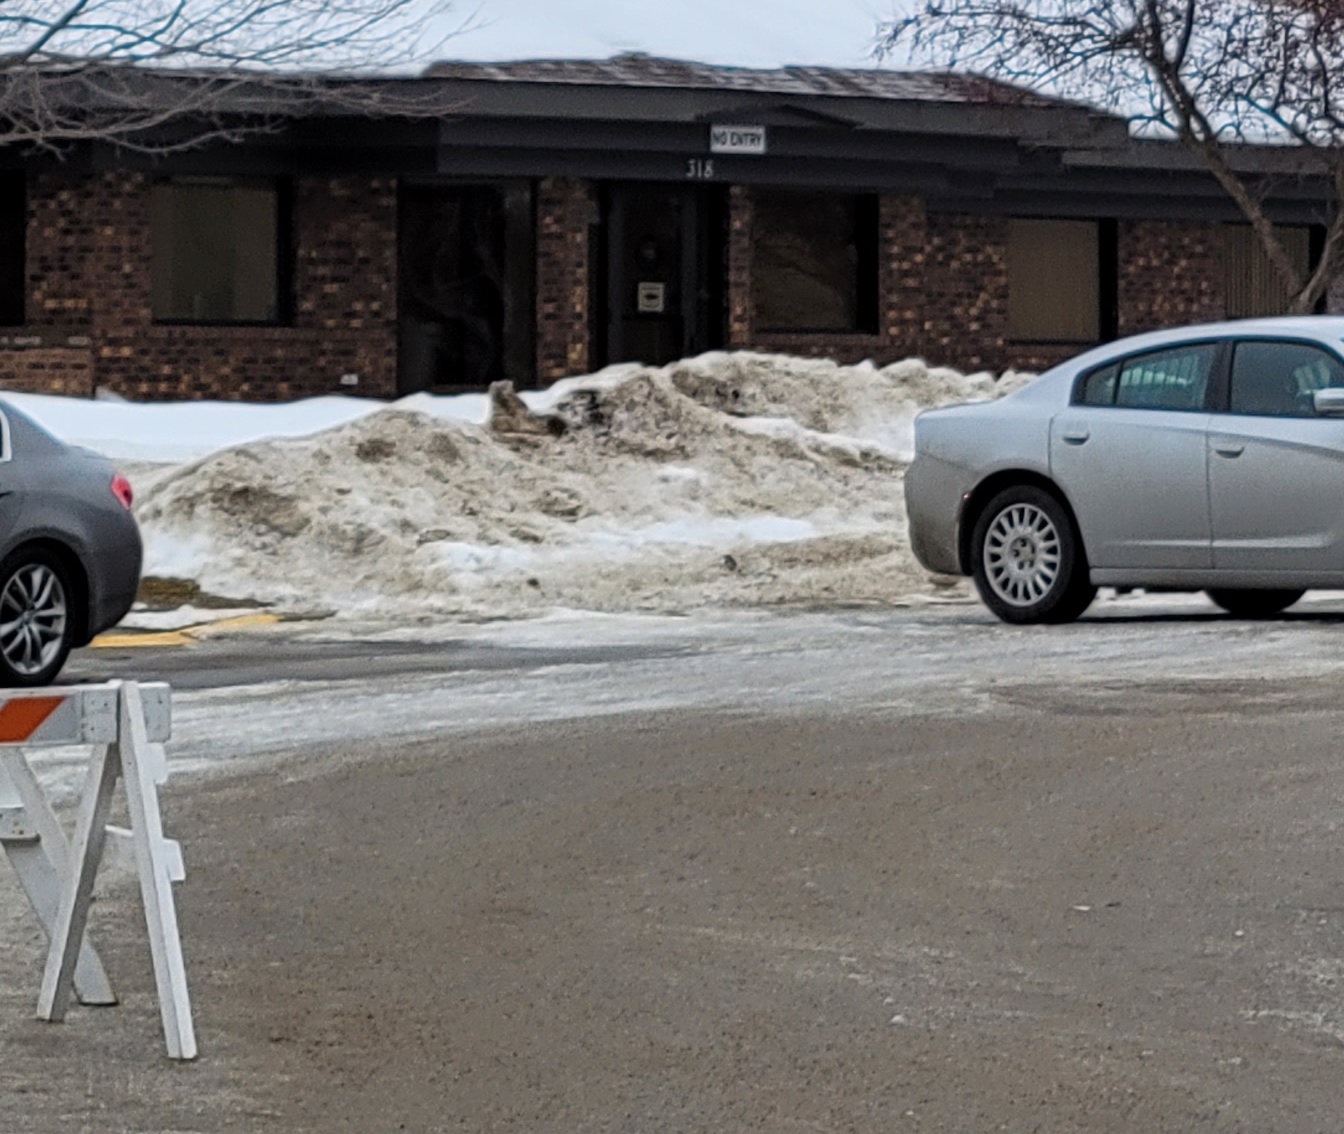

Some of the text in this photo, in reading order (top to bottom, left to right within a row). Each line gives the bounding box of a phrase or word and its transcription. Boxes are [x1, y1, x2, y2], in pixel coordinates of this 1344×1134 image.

[712, 131, 762, 146] NO ENTRY
[686, 159, 714, 178] 318
